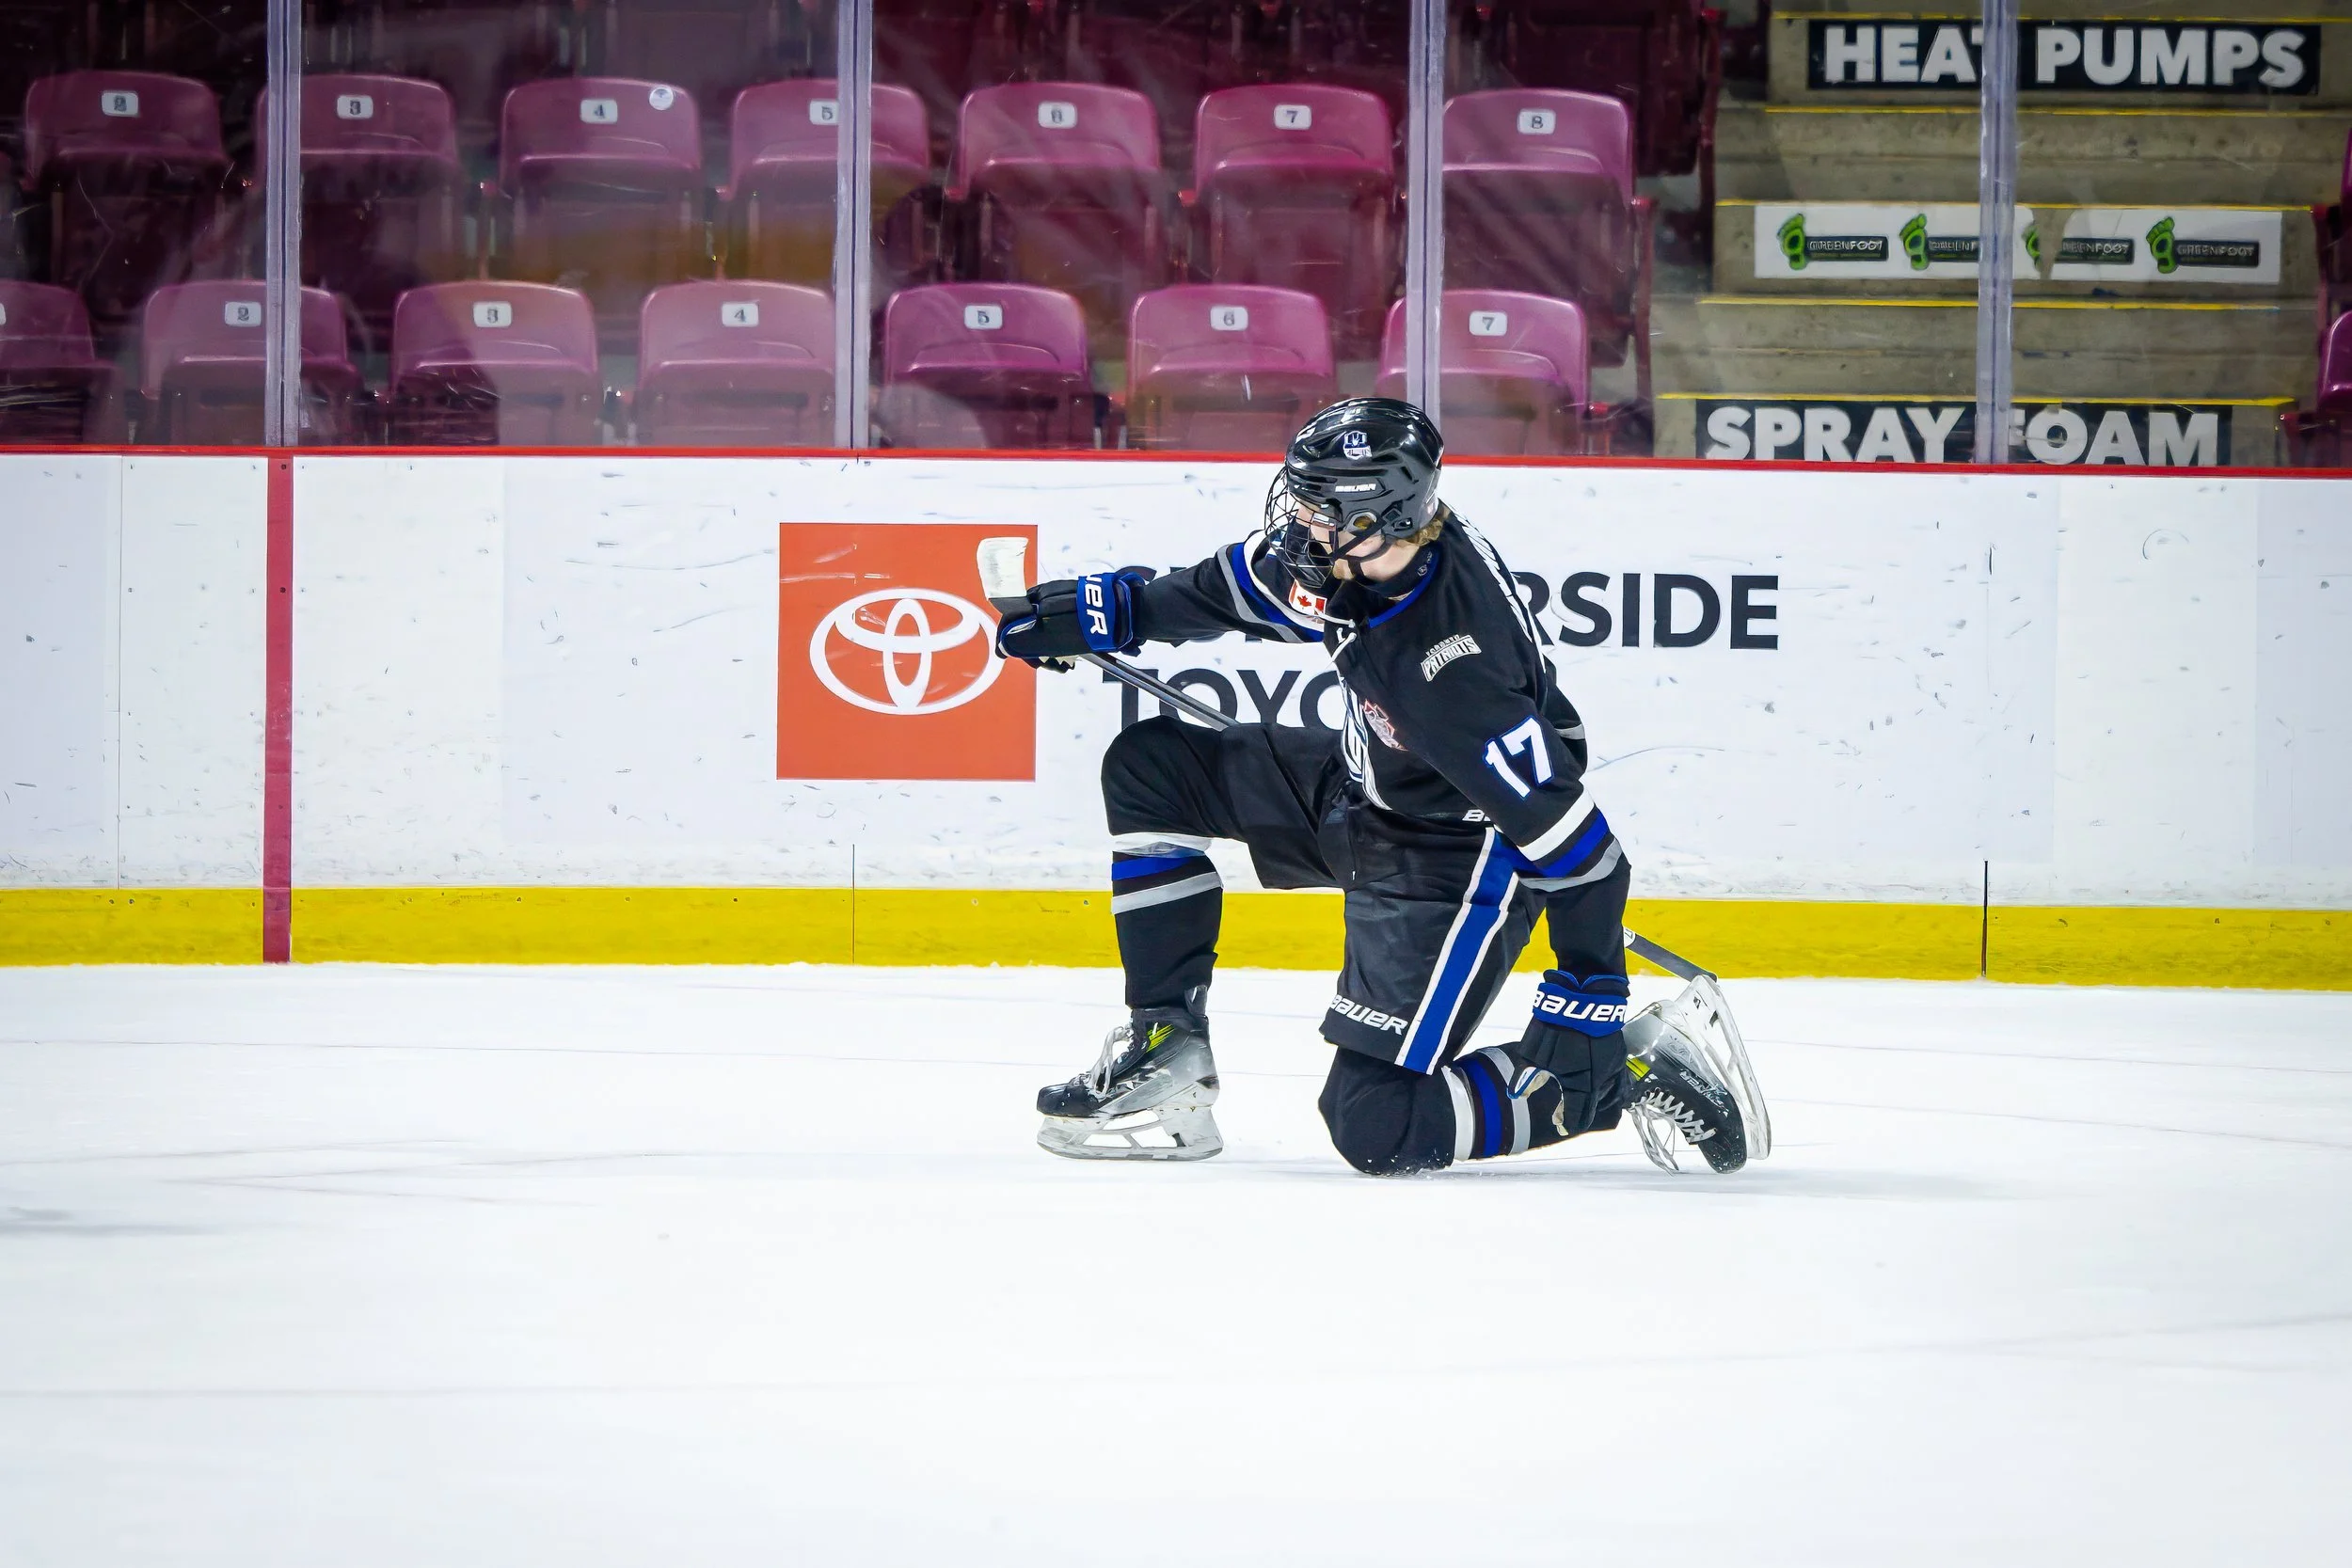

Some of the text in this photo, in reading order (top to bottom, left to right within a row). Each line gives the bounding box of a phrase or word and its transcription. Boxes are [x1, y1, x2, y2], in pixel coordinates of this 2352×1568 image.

[1825, 25, 2305, 87] HEA PUMPS
[1532, 115, 1543, 130] 8
[1482, 316, 1495, 330] 7
[1706, 406, 1965, 463] SPRAY
[1103, 669, 1347, 730] TOYO
[1484, 716, 1553, 800] 17
